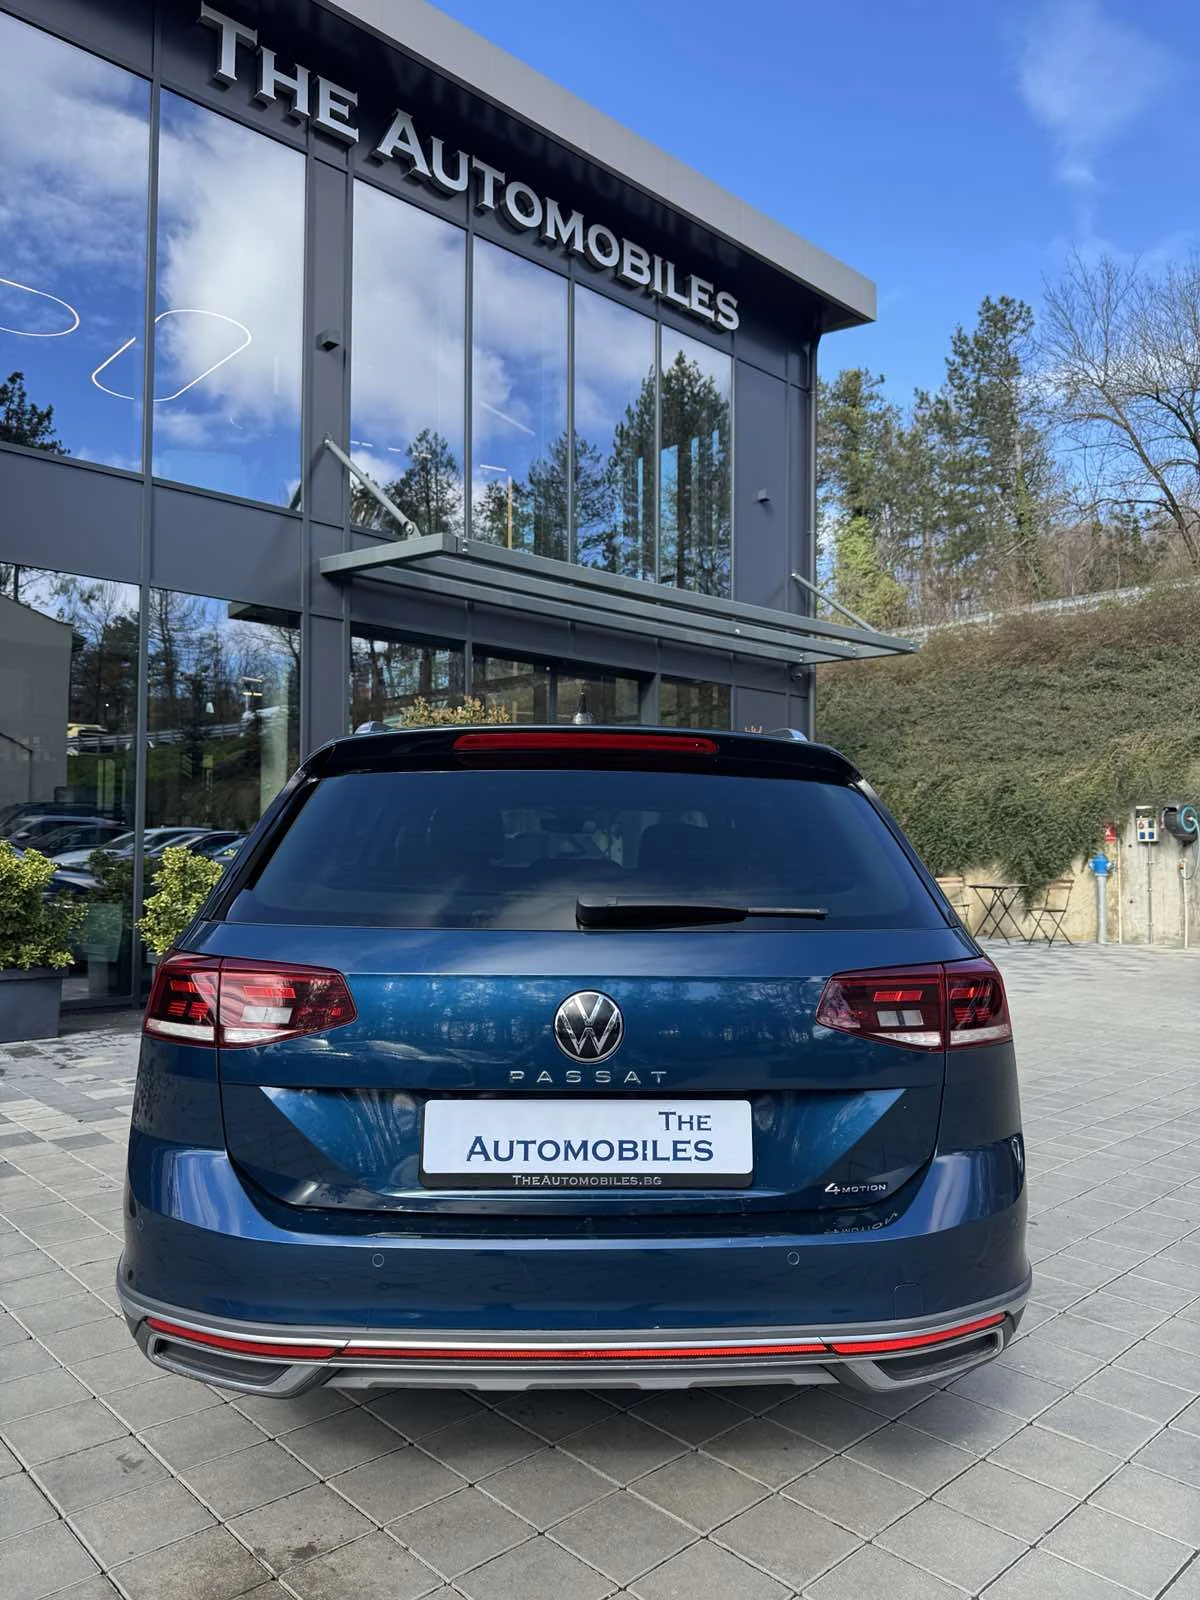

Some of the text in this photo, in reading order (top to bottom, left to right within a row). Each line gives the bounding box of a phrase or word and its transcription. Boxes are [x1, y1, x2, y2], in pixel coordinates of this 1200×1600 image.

[198, 3, 740, 331] THE AUTOMOBILES
[509, 1070, 667, 1084] PASSAT
[658, 1111, 712, 1132] THE
[466, 1135, 714, 1162] AUTOMOBILES
[824, 1182, 887, 1195] 4MOTION
